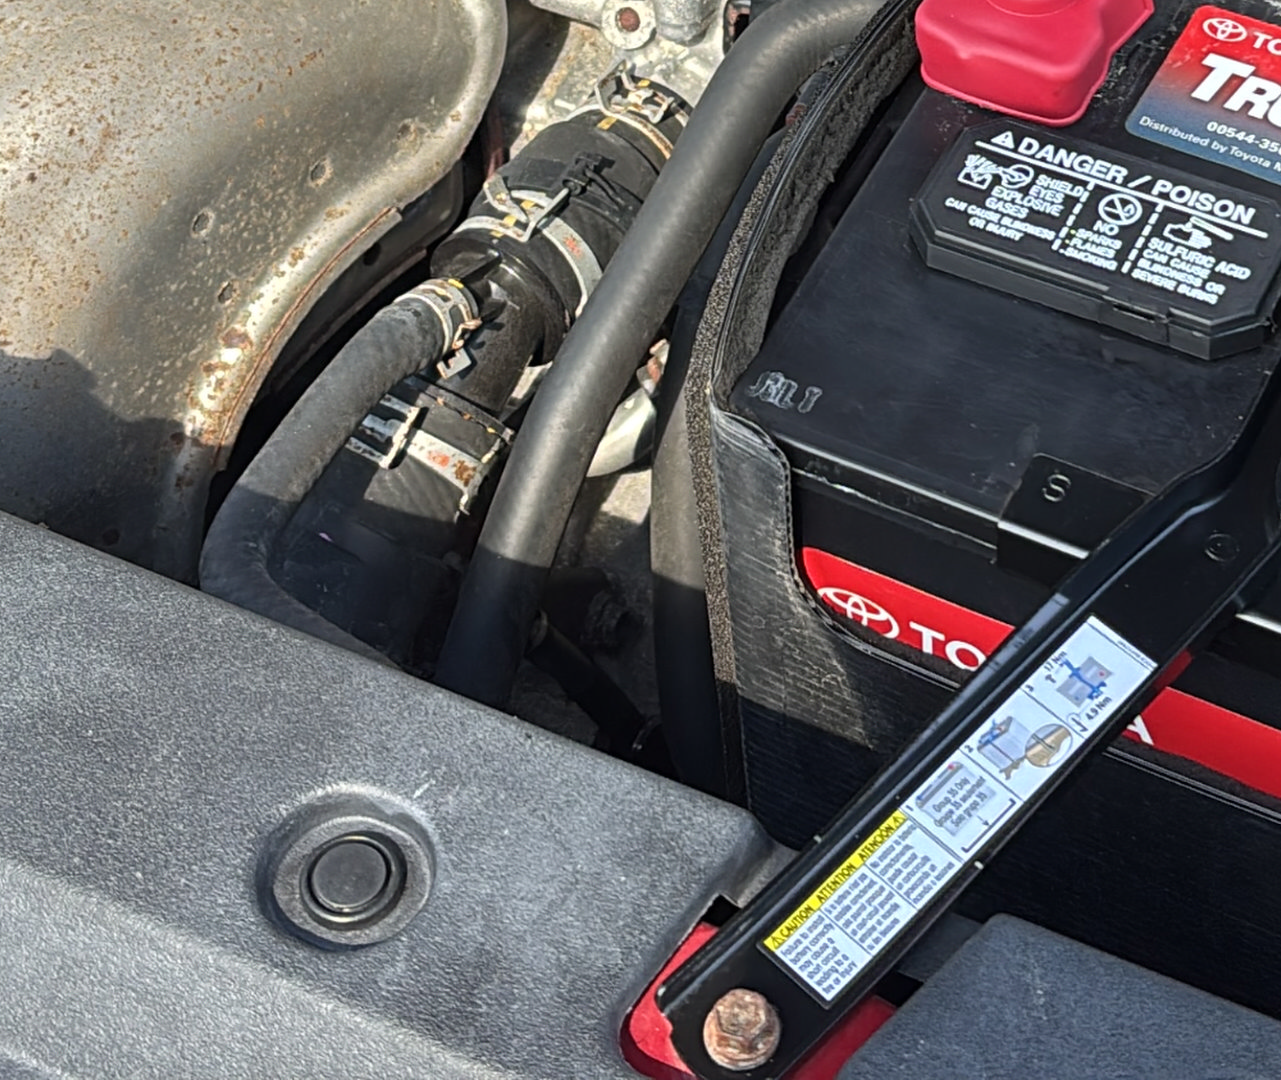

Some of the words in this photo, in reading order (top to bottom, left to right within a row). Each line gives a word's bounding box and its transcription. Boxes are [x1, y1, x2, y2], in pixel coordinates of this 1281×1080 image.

[1139, 115, 1209, 147] Distributed
[1211, 140, 1228, 154] by
[1229, 144, 1270, 169] Toyota
[1015, 137, 1129, 184] DANGER
[1126, 171, 1152, 191] /
[1149, 179, 1256, 225] POISON
[1034, 173, 1085, 197] SHIELD
[989, 185, 1064, 216] EXPLOSIVE
[1027, 184, 1065, 204] EYES
[943, 197, 968, 211] CAN
[965, 204, 1002, 222] CAUSE
[982, 197, 1029, 219] GASES
[967, 216, 986, 228] OR
[1091, 220, 1120, 236] NO
[1068, 237, 1117, 259] FLAMES
[1074, 227, 1123, 250] SPARKS
[1062, 246, 1119, 271] SMOKING
[1140, 249, 1169, 264] CAN
[1167, 257, 1211, 278] CAUSE
[1145, 237, 1216, 268] SULFURIC
[1213, 259, 1252, 280] ACID
[1129, 267, 1177, 290] SEVERE
[1134, 258, 1204, 287] BLINDNESS
[1203, 281, 1226, 295] OR
[1042, 472, 1072, 502] S
[1043, 661, 1055, 672] 17
[1050, 649, 1067, 664] Nm
[1083, 706, 1099, 721] 4.9
[1094, 694, 1112, 710] Nm
[931, 793, 952, 813] Group
[946, 786, 959, 798] 35
[953, 775, 970, 791] Only
[778, 903, 814, 939] CAUTION
[814, 860, 857, 903] ATTENTION
